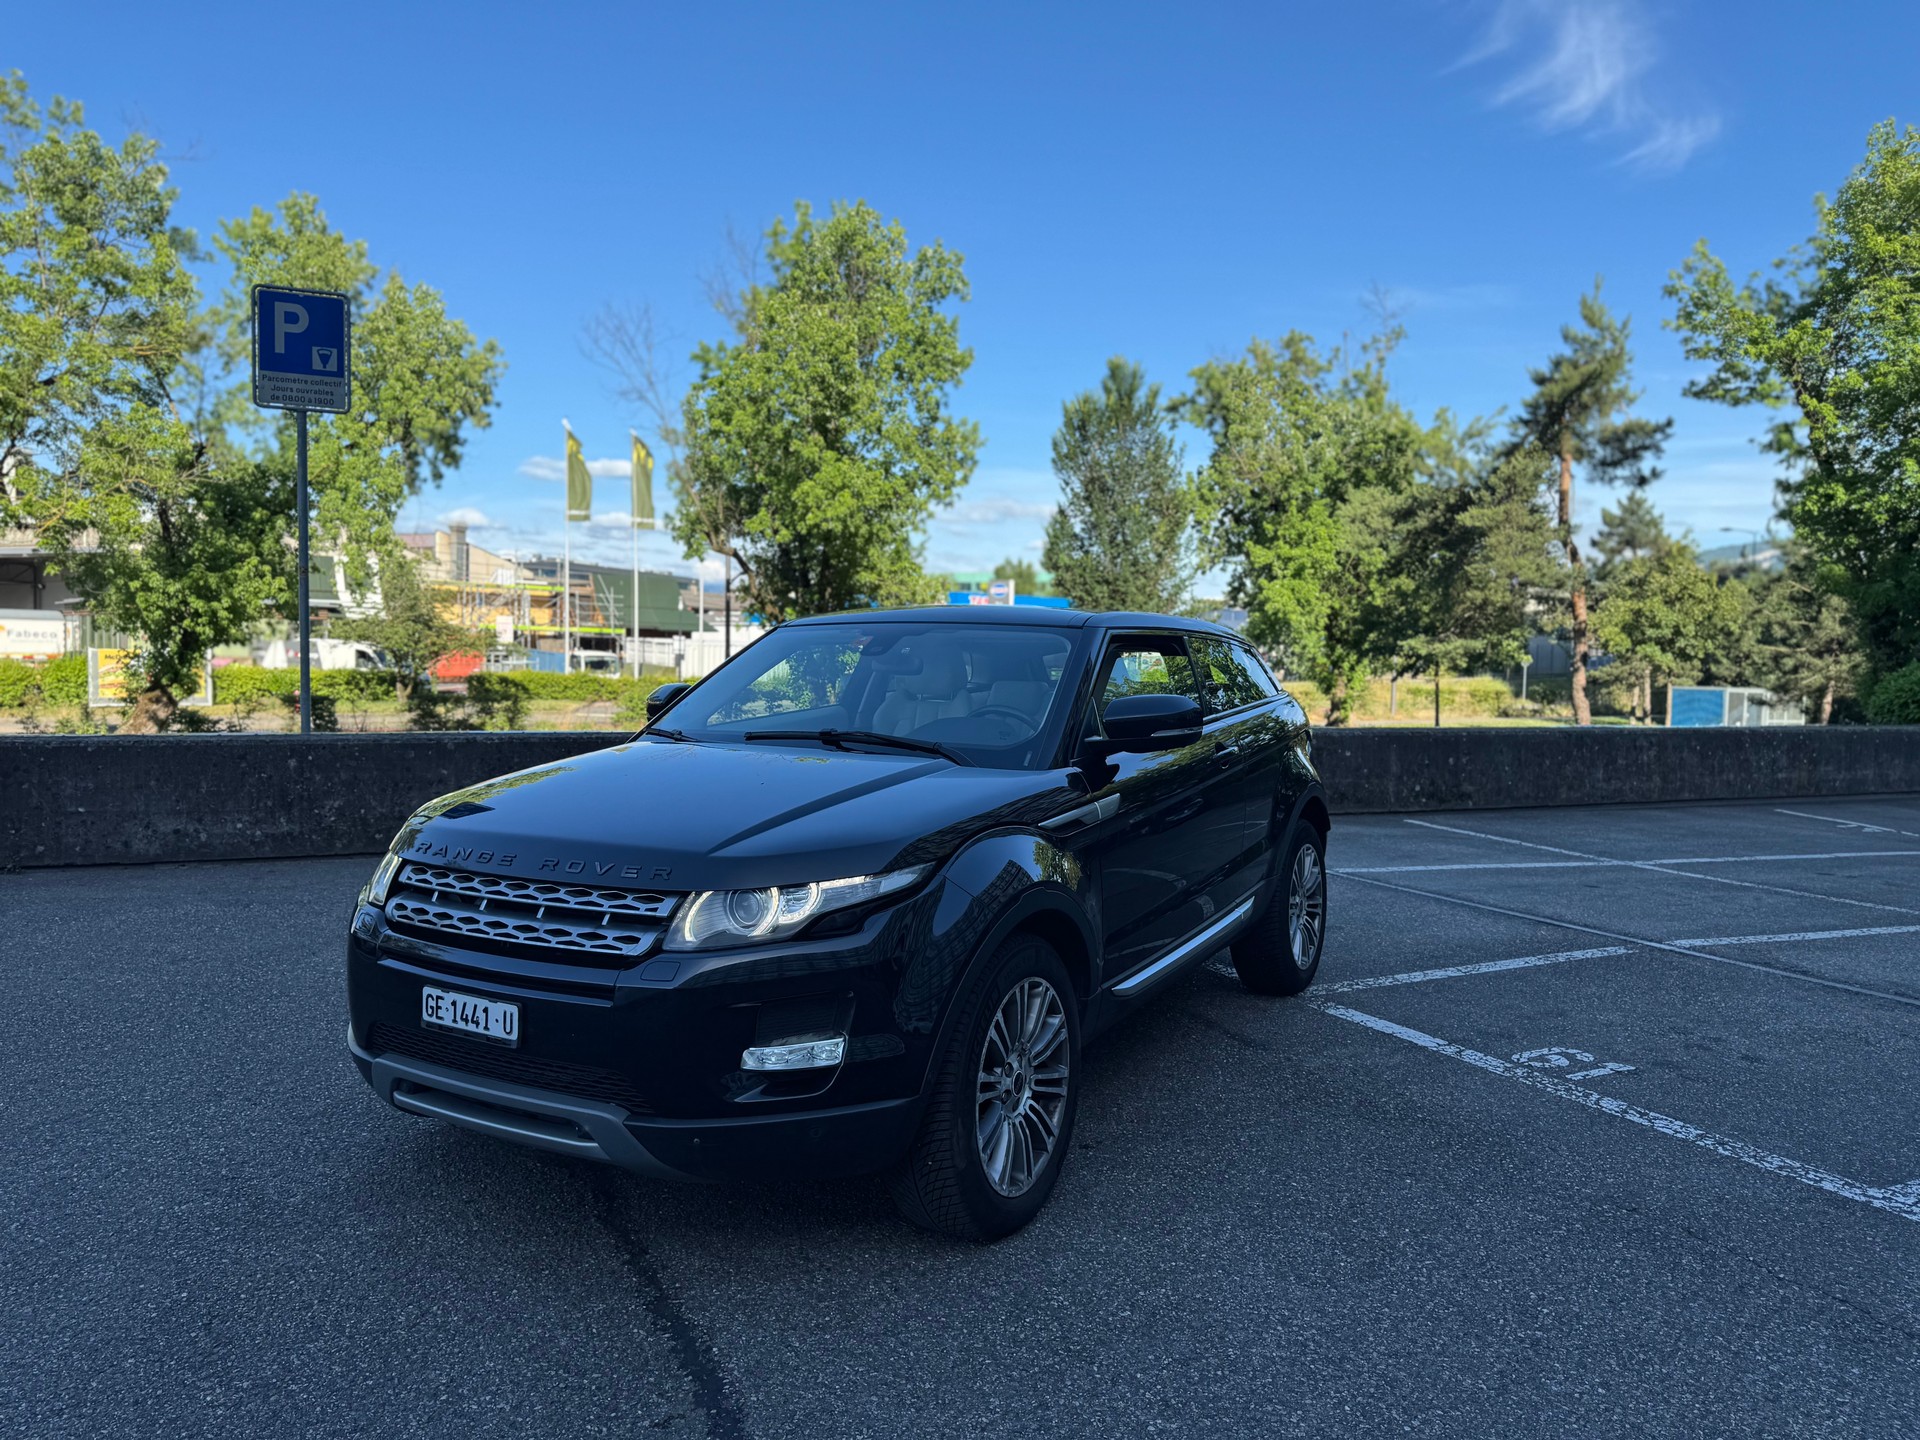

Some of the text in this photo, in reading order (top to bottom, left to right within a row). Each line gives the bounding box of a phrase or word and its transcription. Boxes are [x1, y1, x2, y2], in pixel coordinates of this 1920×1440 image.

[274, 301, 309, 354] P
[271, 384, 334, 396] Jours ouvrables
[310, 380, 342, 388] collectif
[7, 629, 57, 638] Fabeco
[415, 841, 673, 881] RANGE ROVER
